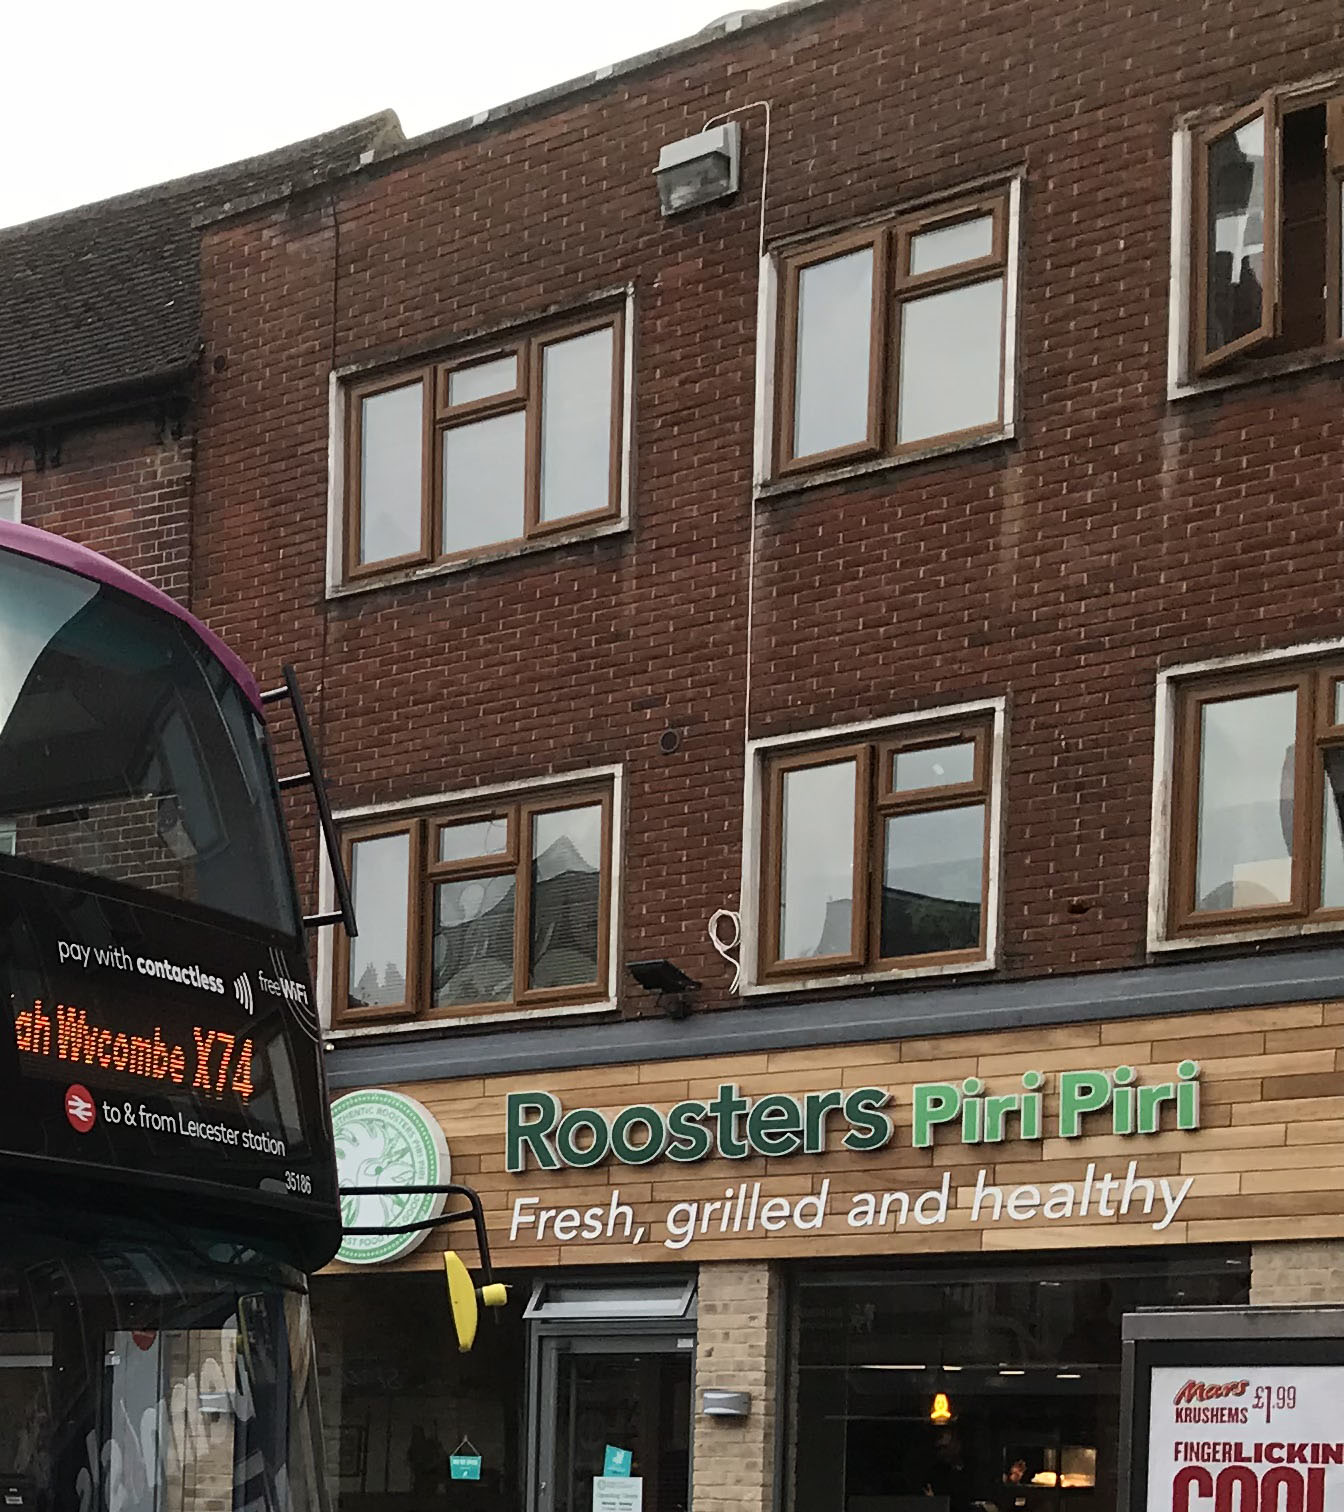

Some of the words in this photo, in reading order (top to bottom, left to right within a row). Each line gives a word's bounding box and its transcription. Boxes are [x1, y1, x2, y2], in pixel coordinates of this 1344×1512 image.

[57, 940, 91, 968] pay
[94, 945, 134, 972] with
[136, 955, 225, 995] contactless
[258, 970, 281, 997] free
[280, 977, 309, 1005] WiFi
[192, 1026, 255, 1098] X74
[102, 1100, 121, 1124] to
[123, 1102, 138, 1127] &
[138, 1104, 177, 1134] from
[178, 1112, 240, 1146] Leicester
[242, 1128, 286, 1157] station
[335, 1106, 374, 1129] THENTIC
[505, 1081, 894, 1174] Roosters
[912, 1070, 1046, 1149] Piri
[1058, 1058, 1201, 1138] Piri
[284, 1171, 312, 1195] 35186
[508, 1188, 646, 1246] Fresh,
[662, 1179, 830, 1250] grilled
[848, 1172, 953, 1228] and
[970, 1160, 1196, 1231] healthy
[1173, 1379, 1250, 1406] Mars
[1252, 1385, 1297, 1424] £1.99
[1175, 1407, 1248, 1424] KRUSHEMS
